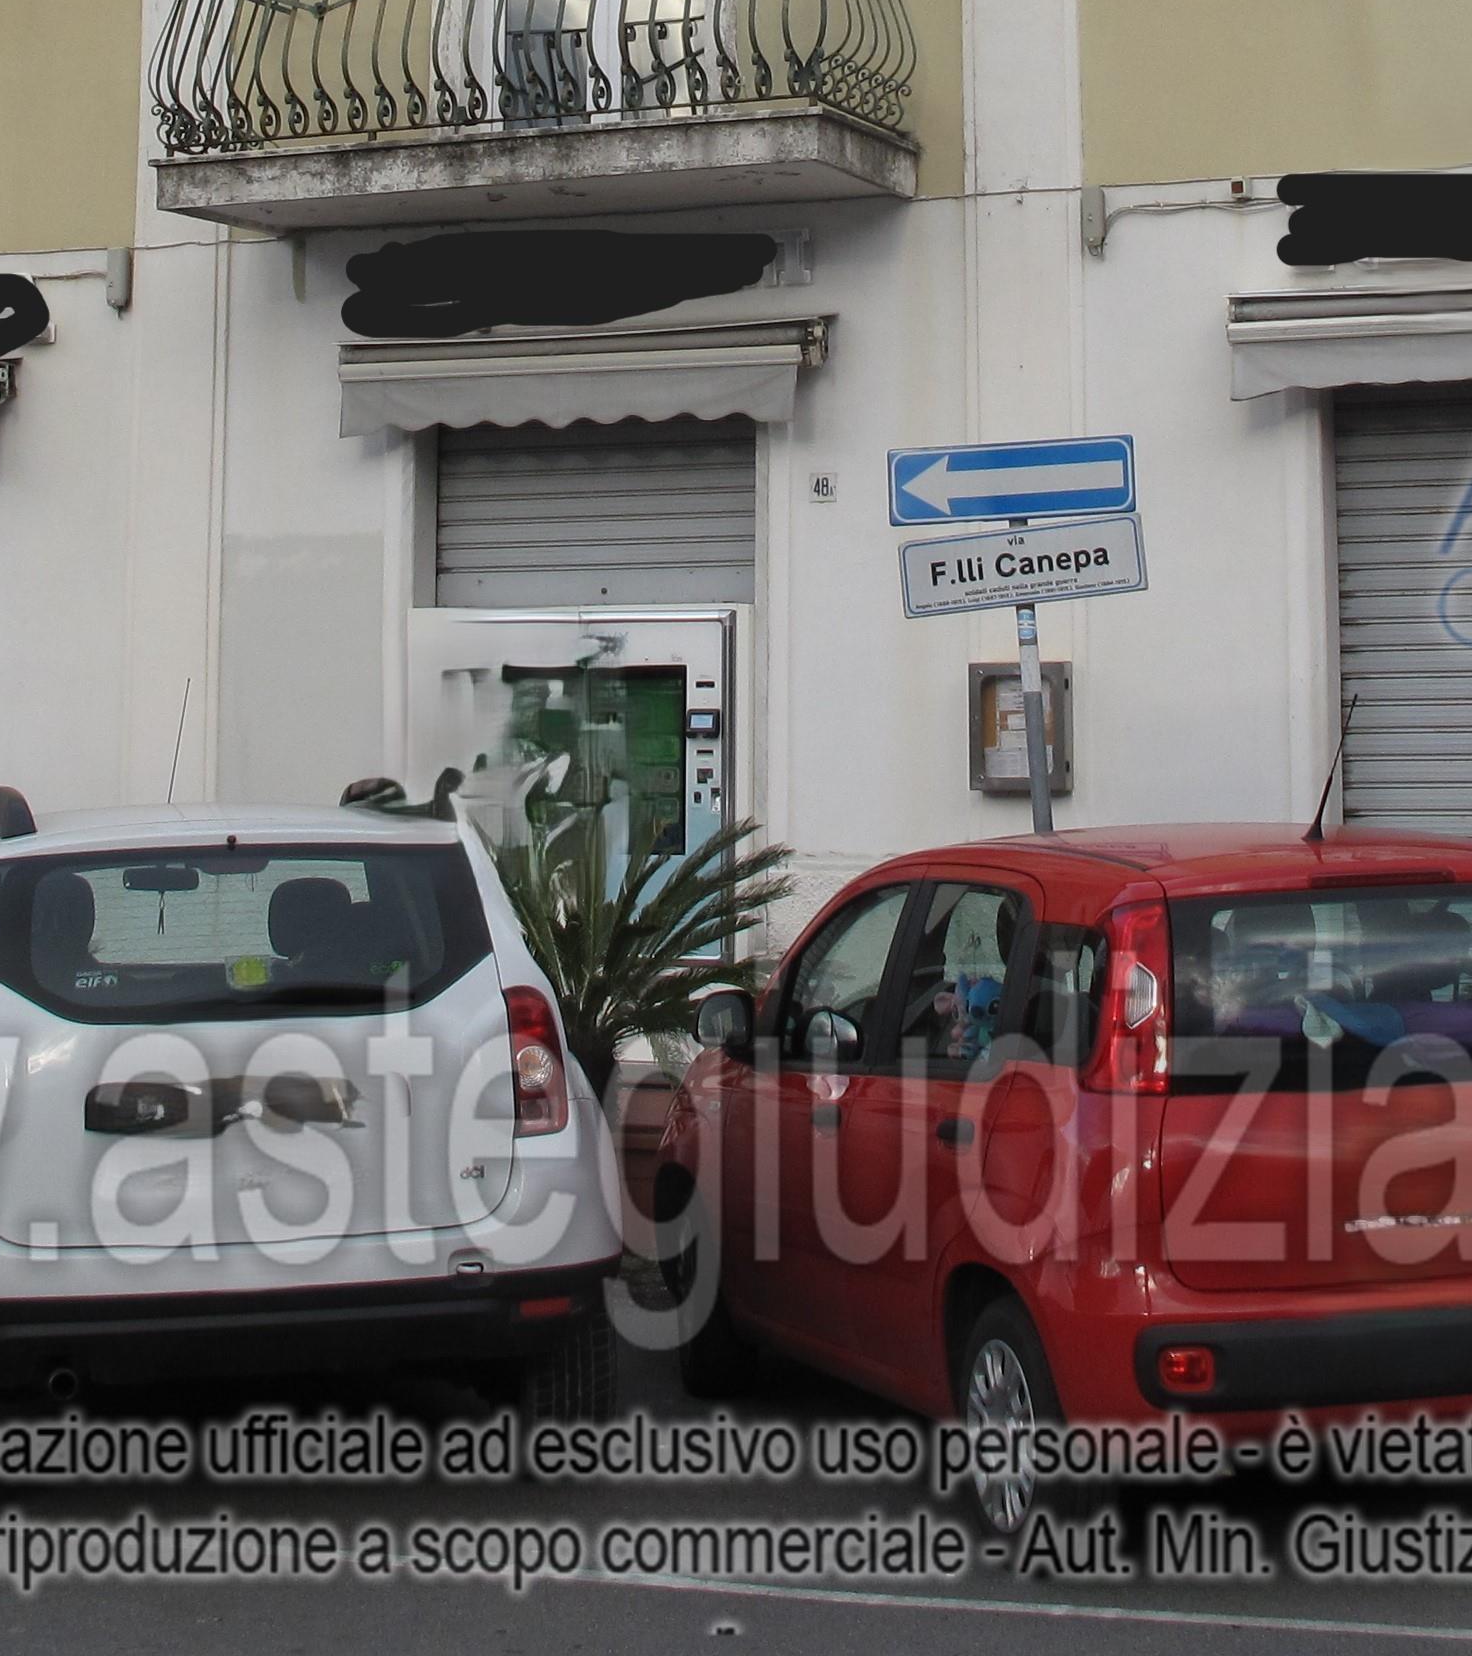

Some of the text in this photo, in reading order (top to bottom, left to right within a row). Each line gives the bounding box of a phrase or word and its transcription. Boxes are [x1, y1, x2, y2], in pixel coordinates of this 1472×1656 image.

[1007, 535, 1025, 546] via
[930, 546, 1110, 587] F.lli Canepa
